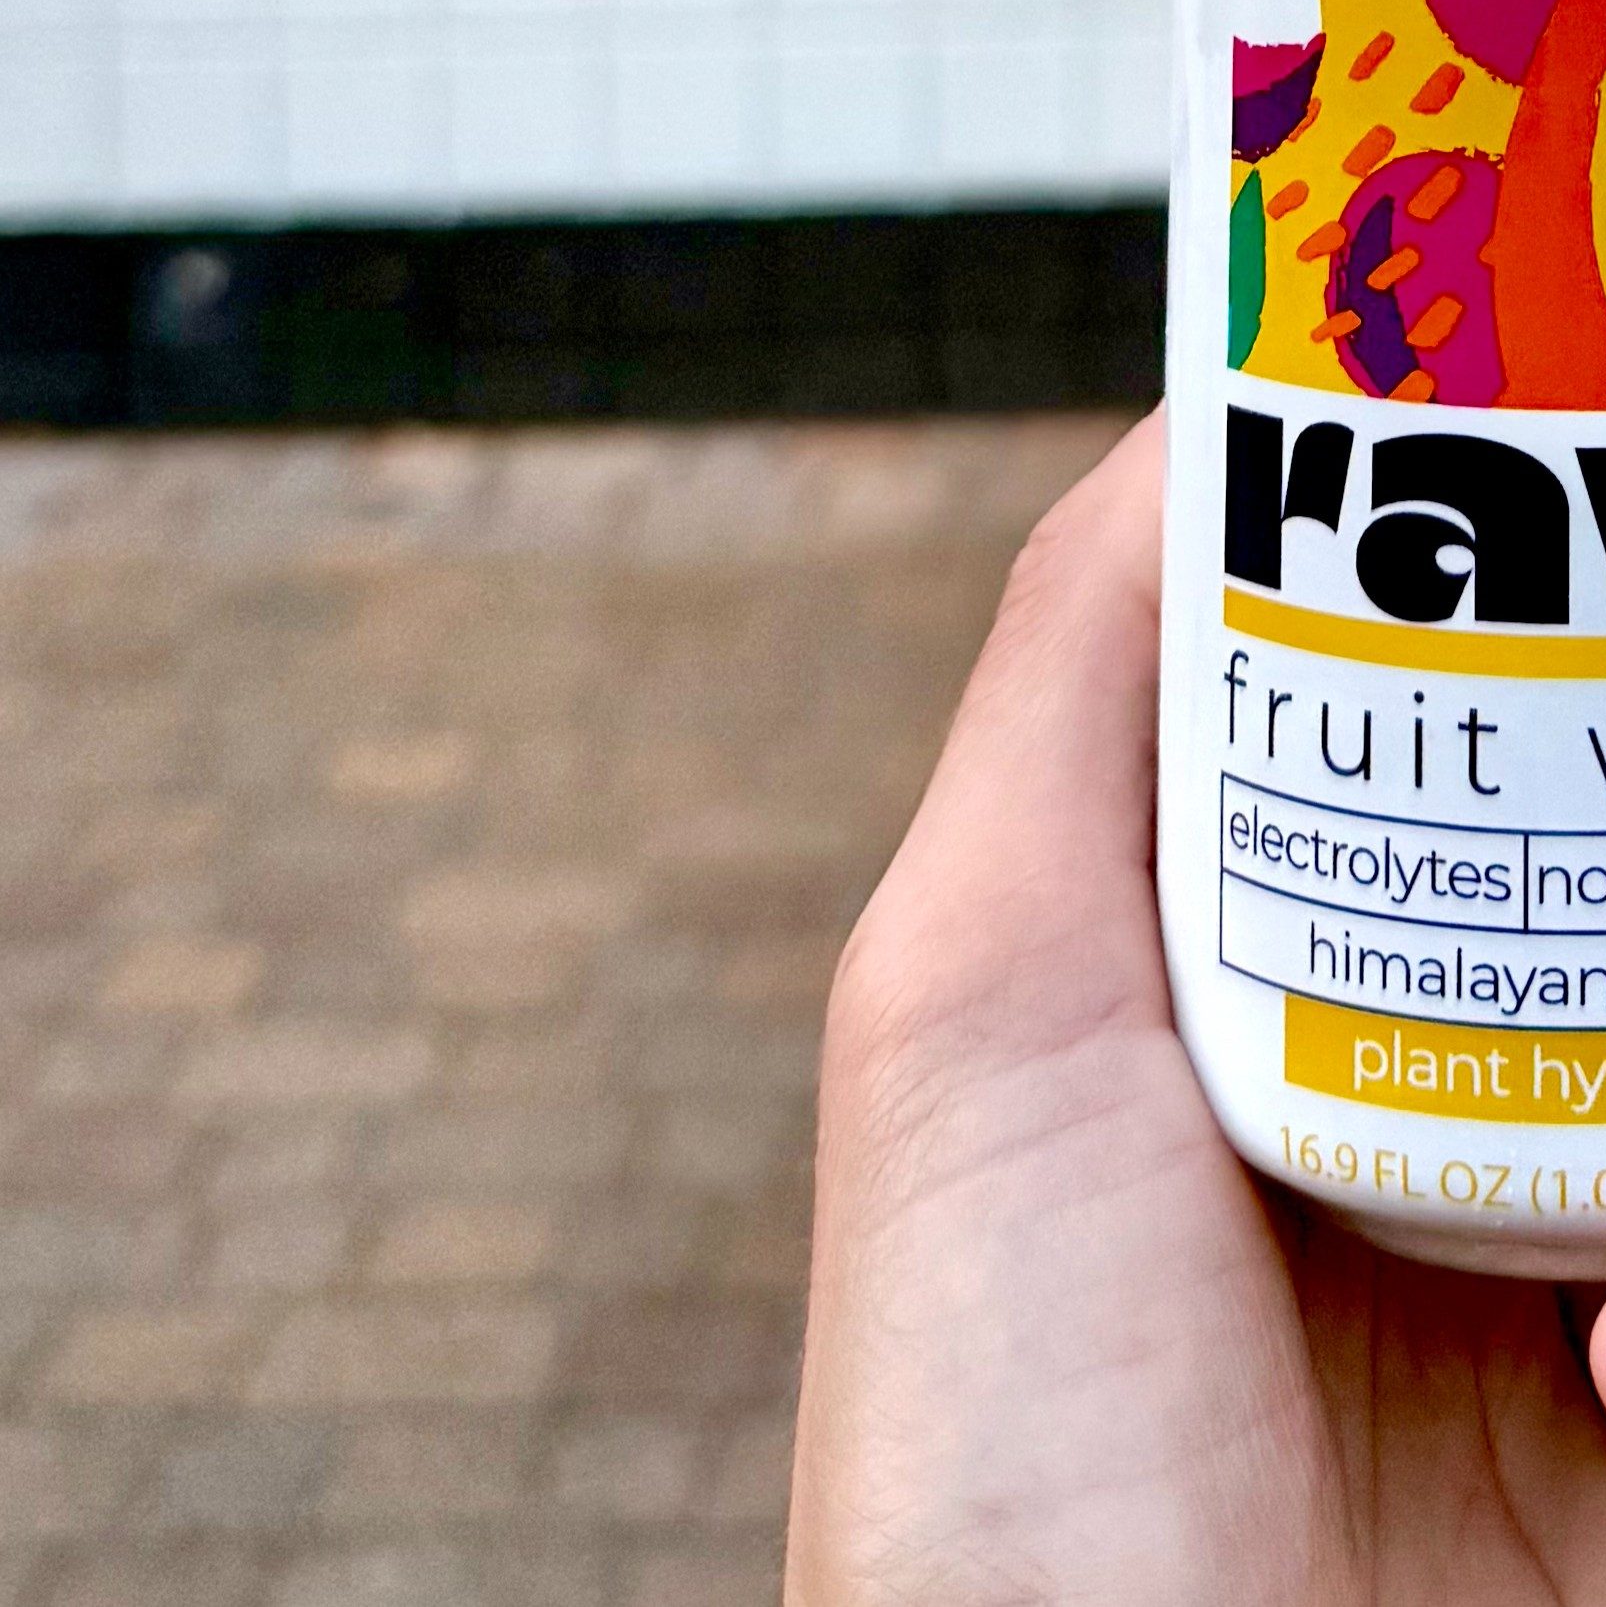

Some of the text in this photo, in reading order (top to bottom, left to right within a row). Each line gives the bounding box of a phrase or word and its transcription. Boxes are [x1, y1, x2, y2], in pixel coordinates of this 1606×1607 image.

[1224, 650, 1501, 796] fruit
[1228, 802, 1512, 902] electrolytes
[1352, 1031, 1510, 1098] plant
[1278, 1124, 1359, 1184] 16.9
[1374, 1150, 1424, 1198] FL
[1440, 1158, 1514, 1206] OZ
